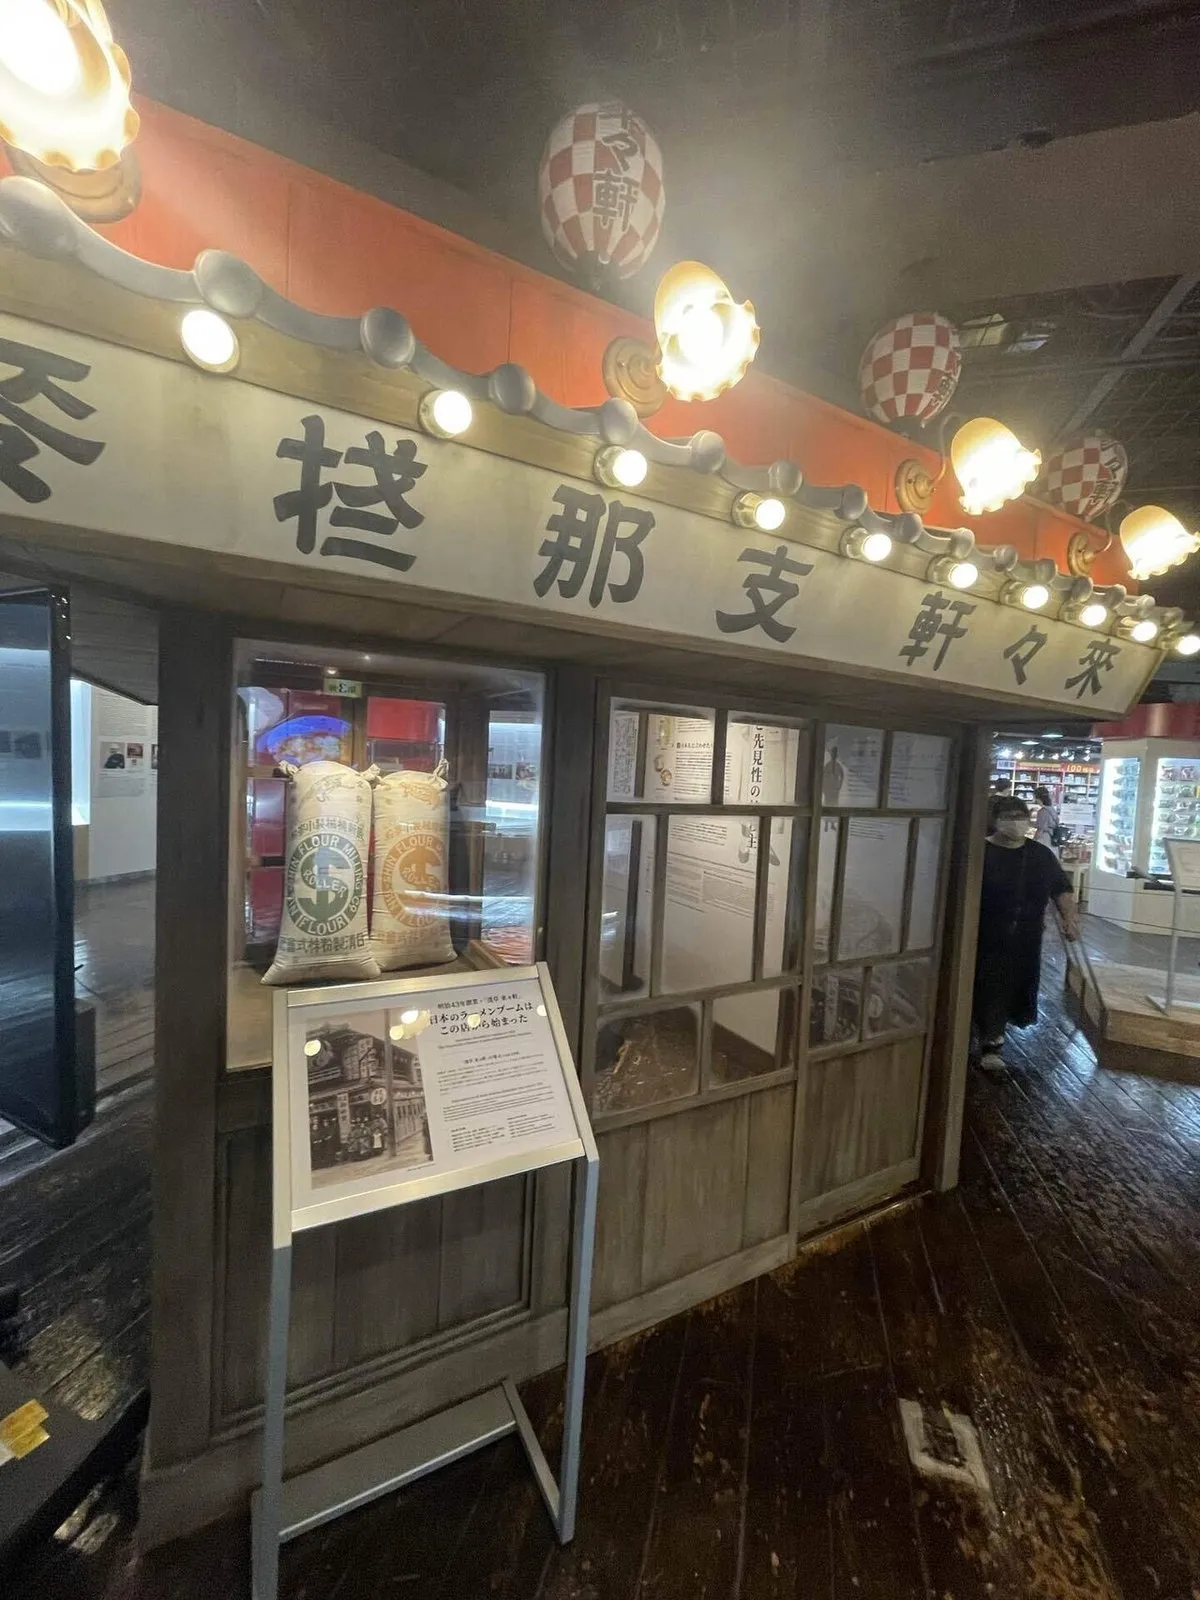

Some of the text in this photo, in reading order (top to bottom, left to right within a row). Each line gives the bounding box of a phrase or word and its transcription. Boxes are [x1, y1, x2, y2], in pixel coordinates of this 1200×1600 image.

[299, 834, 341, 855] FLOUR
[303, 869, 348, 898] ROLLER
[298, 915, 347, 936] FLOUR
